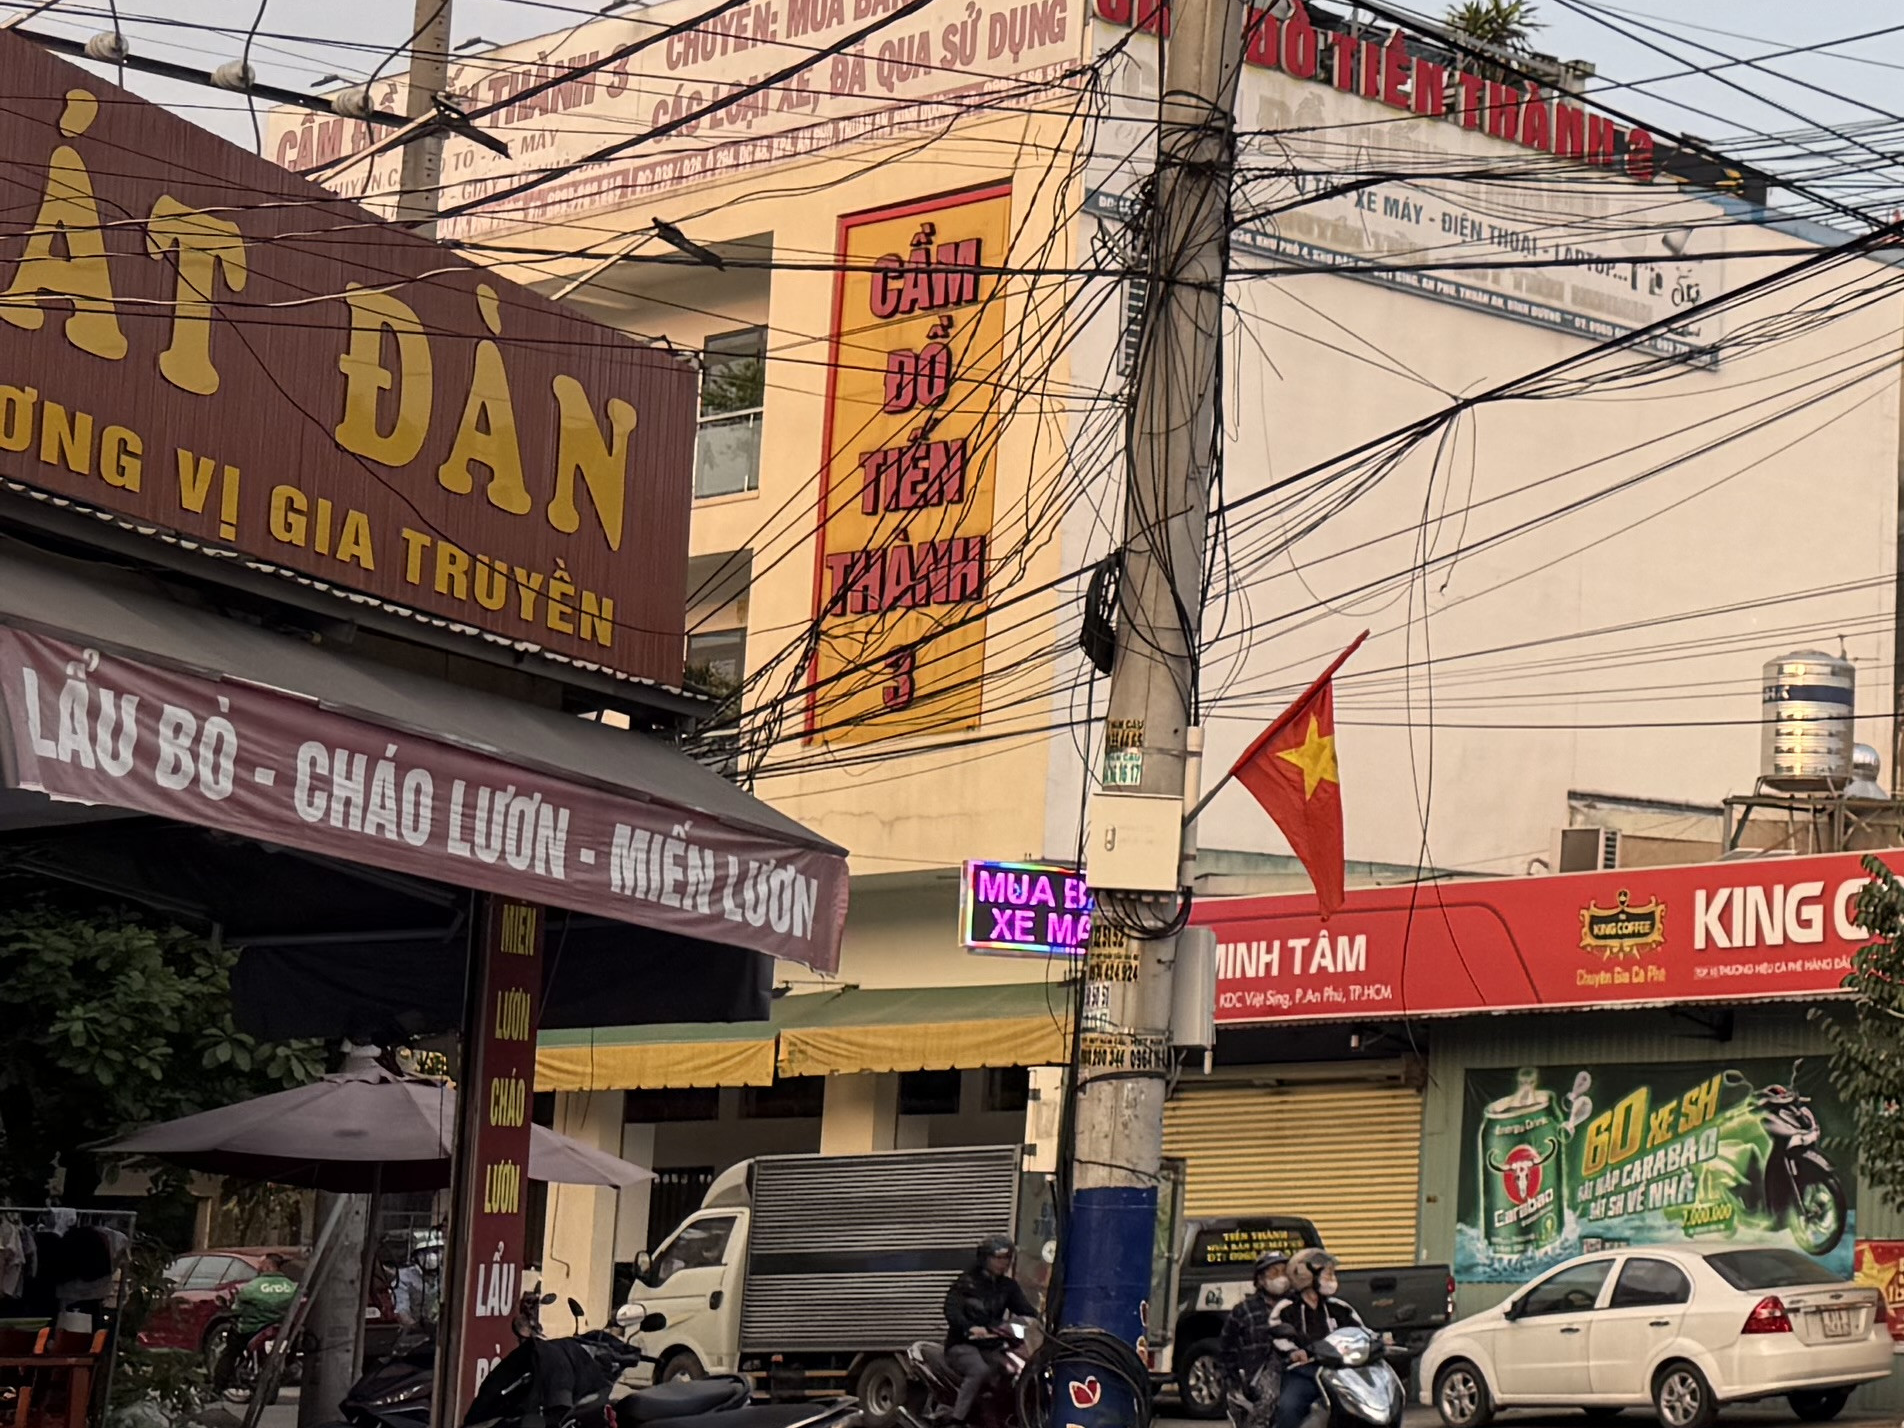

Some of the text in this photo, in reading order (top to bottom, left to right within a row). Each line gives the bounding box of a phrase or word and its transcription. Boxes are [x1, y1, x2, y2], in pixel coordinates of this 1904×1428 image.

[878, 31, 932, 93] QUA
[941, 1, 982, 70] SỬ
[1355, 188, 1377, 213] XE
[1384, 196, 1424, 225] MÁY
[335, 282, 637, 552] ĐÀN
[858, 415, 968, 518] TIẾN
[177, 447, 241, 542] VỊ
[270, 484, 375, 572] GIA
[401, 527, 613, 648] TRUYỀN
[826, 528, 986, 617] THÀNH
[156, 696, 238, 802] BÒ
[294, 744, 433, 849] CHÁO
[448, 776, 571, 881] LƯƠN
[610, 819, 715, 916] MIẾN
[724, 852, 819, 942] LƯƠN
[978, 870, 1056, 909] MUA
[1693, 880, 1825, 952] KING
[990, 907, 1036, 942] XE
[1287, 929, 1368, 976] TÂM
[489, 1068, 526, 1129] CHÁO
[1582, 1072, 1724, 1177] 60 XE SH
[484, 1158, 520, 1214] LƯƠN
[1621, 1126, 1721, 1188] CARABAO
[1649, 1166, 1697, 1210] NHÀ
[1494, 1188, 1555, 1229] Carabao
[260, 1282, 292, 1293] Grab
[475, 1240, 516, 1317] LẨU
